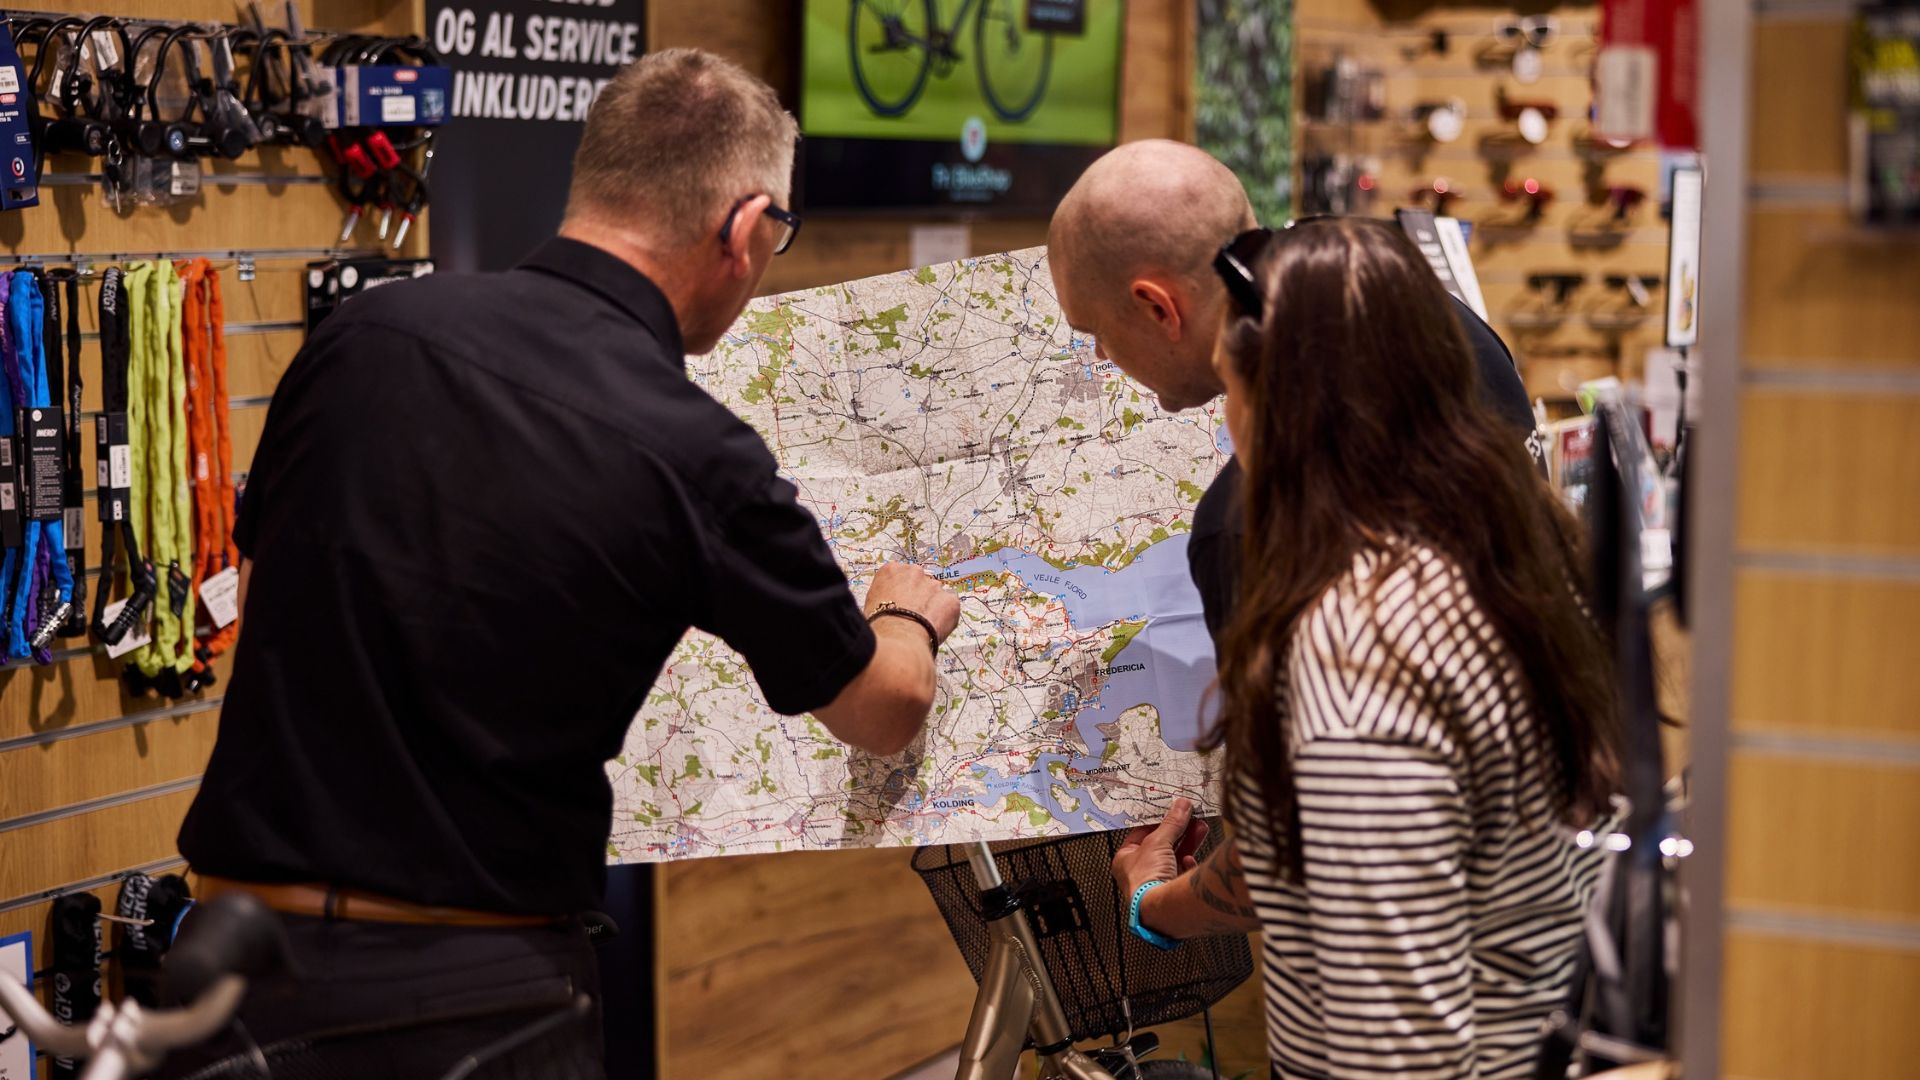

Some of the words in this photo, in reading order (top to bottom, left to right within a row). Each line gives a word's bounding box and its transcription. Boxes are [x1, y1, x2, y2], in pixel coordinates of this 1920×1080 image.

[435, 7, 476, 56] OG
[481, 11, 517, 58] AL
[523, 14, 639, 65] SERVICE
[1095, 362, 1117, 372] HOR
[932, 570, 960, 580] VEJLE
[1033, 573, 1061, 585] VEJLE
[1063, 580, 1088, 600] FJORD
[1094, 663, 1146, 677] FREDERICIA
[1085, 763, 1131, 776] MIDDELFART
[932, 798, 975, 810] KOLDING
